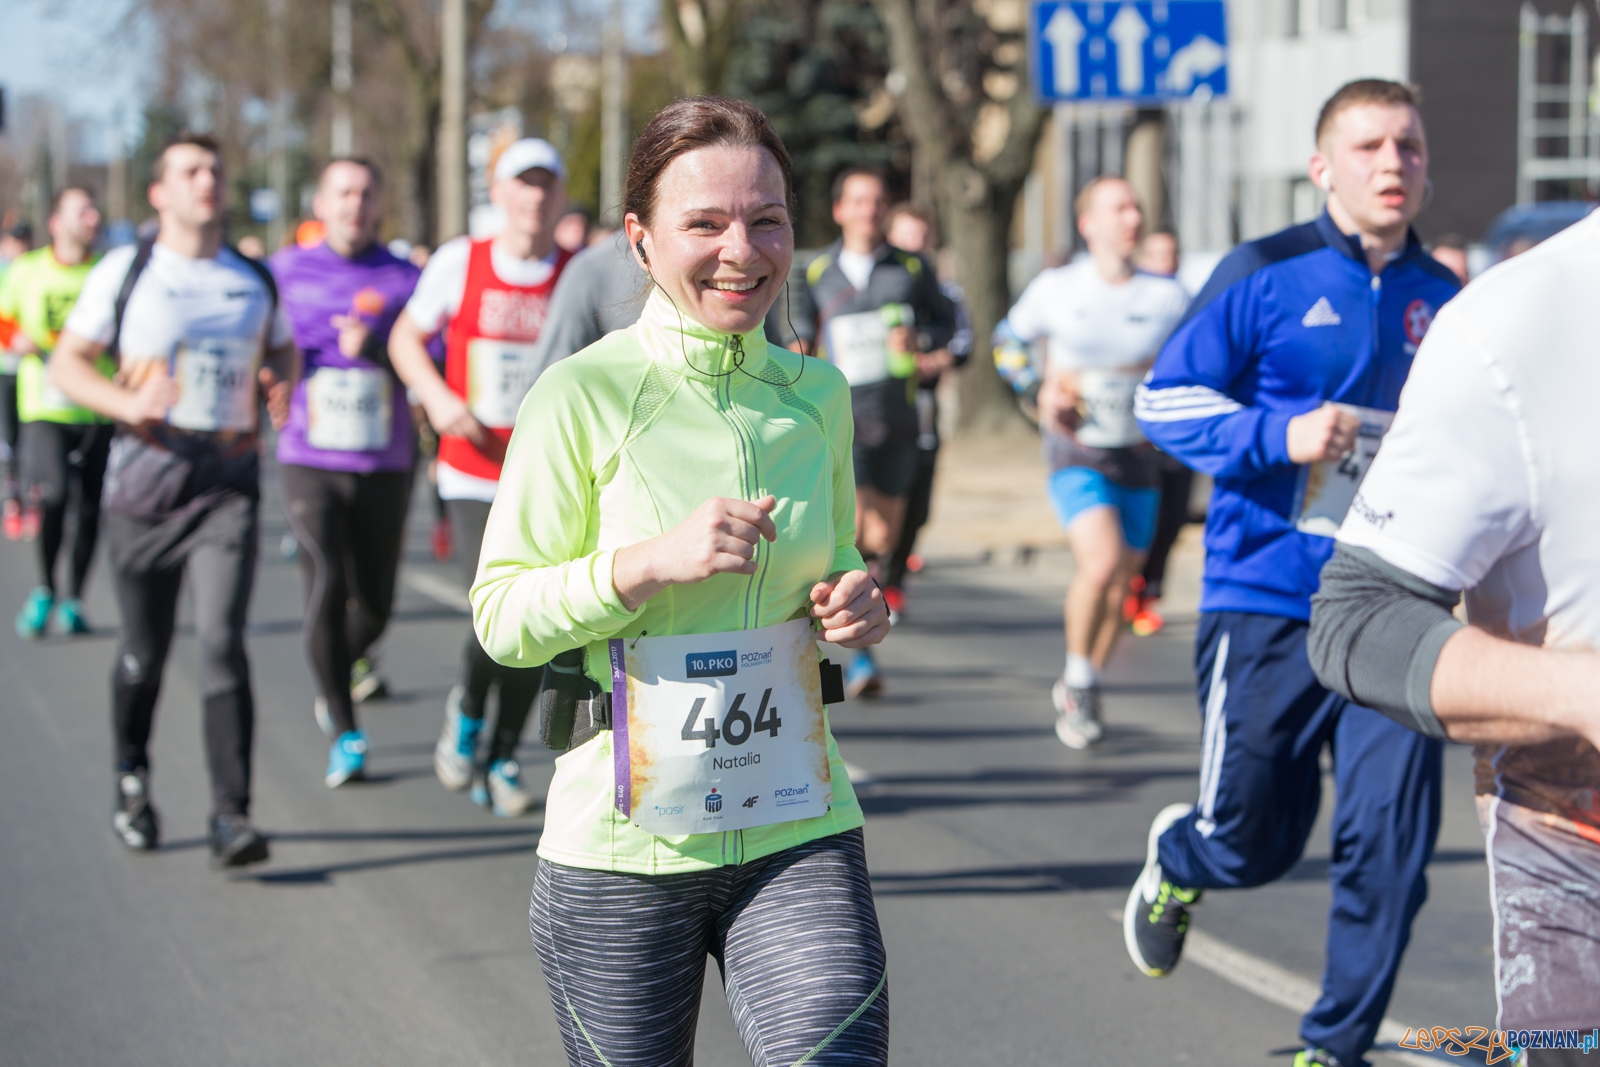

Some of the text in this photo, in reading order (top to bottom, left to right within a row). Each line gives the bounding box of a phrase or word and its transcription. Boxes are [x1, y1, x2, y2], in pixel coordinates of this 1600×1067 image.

[611, 645, 620, 679] 26.03.2017
[691, 657, 734, 671] 10. PKO
[681, 687, 782, 748] 464
[713, 752, 761, 770] Natalia
[742, 795, 760, 808] 4F
